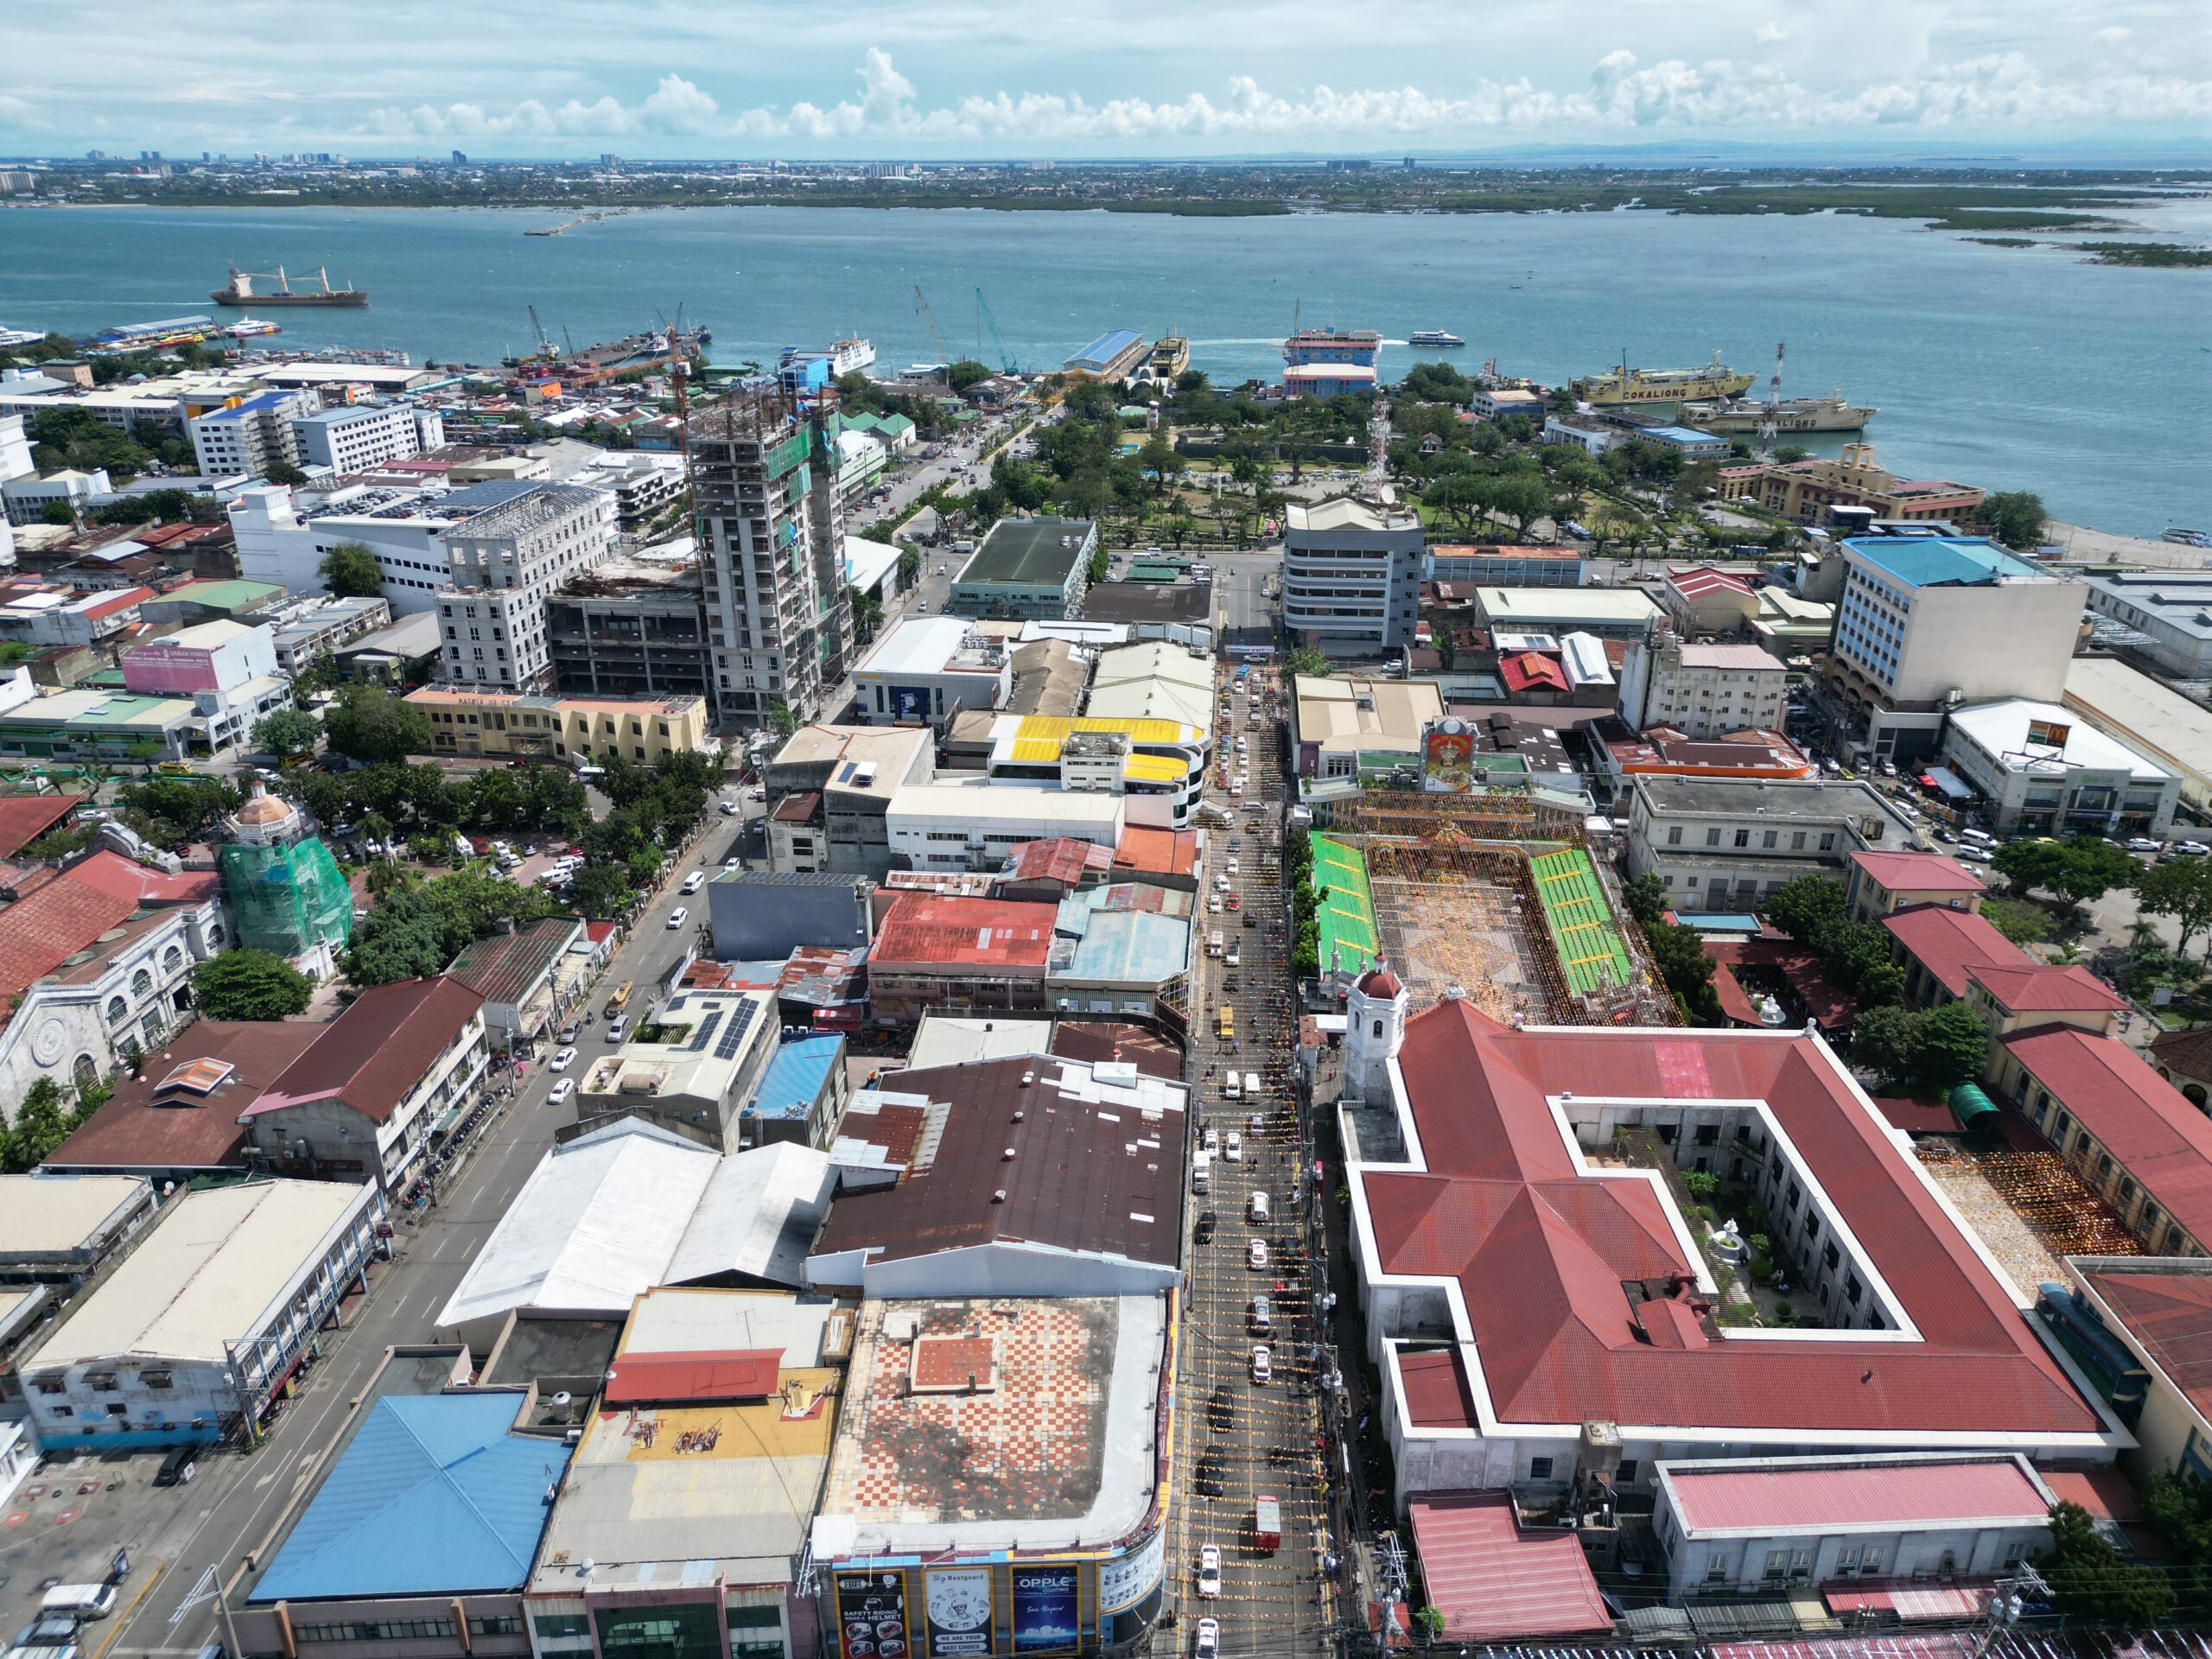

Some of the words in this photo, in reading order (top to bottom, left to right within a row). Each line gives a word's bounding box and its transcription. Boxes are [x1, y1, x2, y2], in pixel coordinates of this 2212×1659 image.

[1624, 389, 1687, 399] COKALIONG
[1752, 419, 1817, 428] COALIONG
[1020, 1577, 1070, 1587] OPPLE
[1040, 1605, 1065, 1615] Beyond
